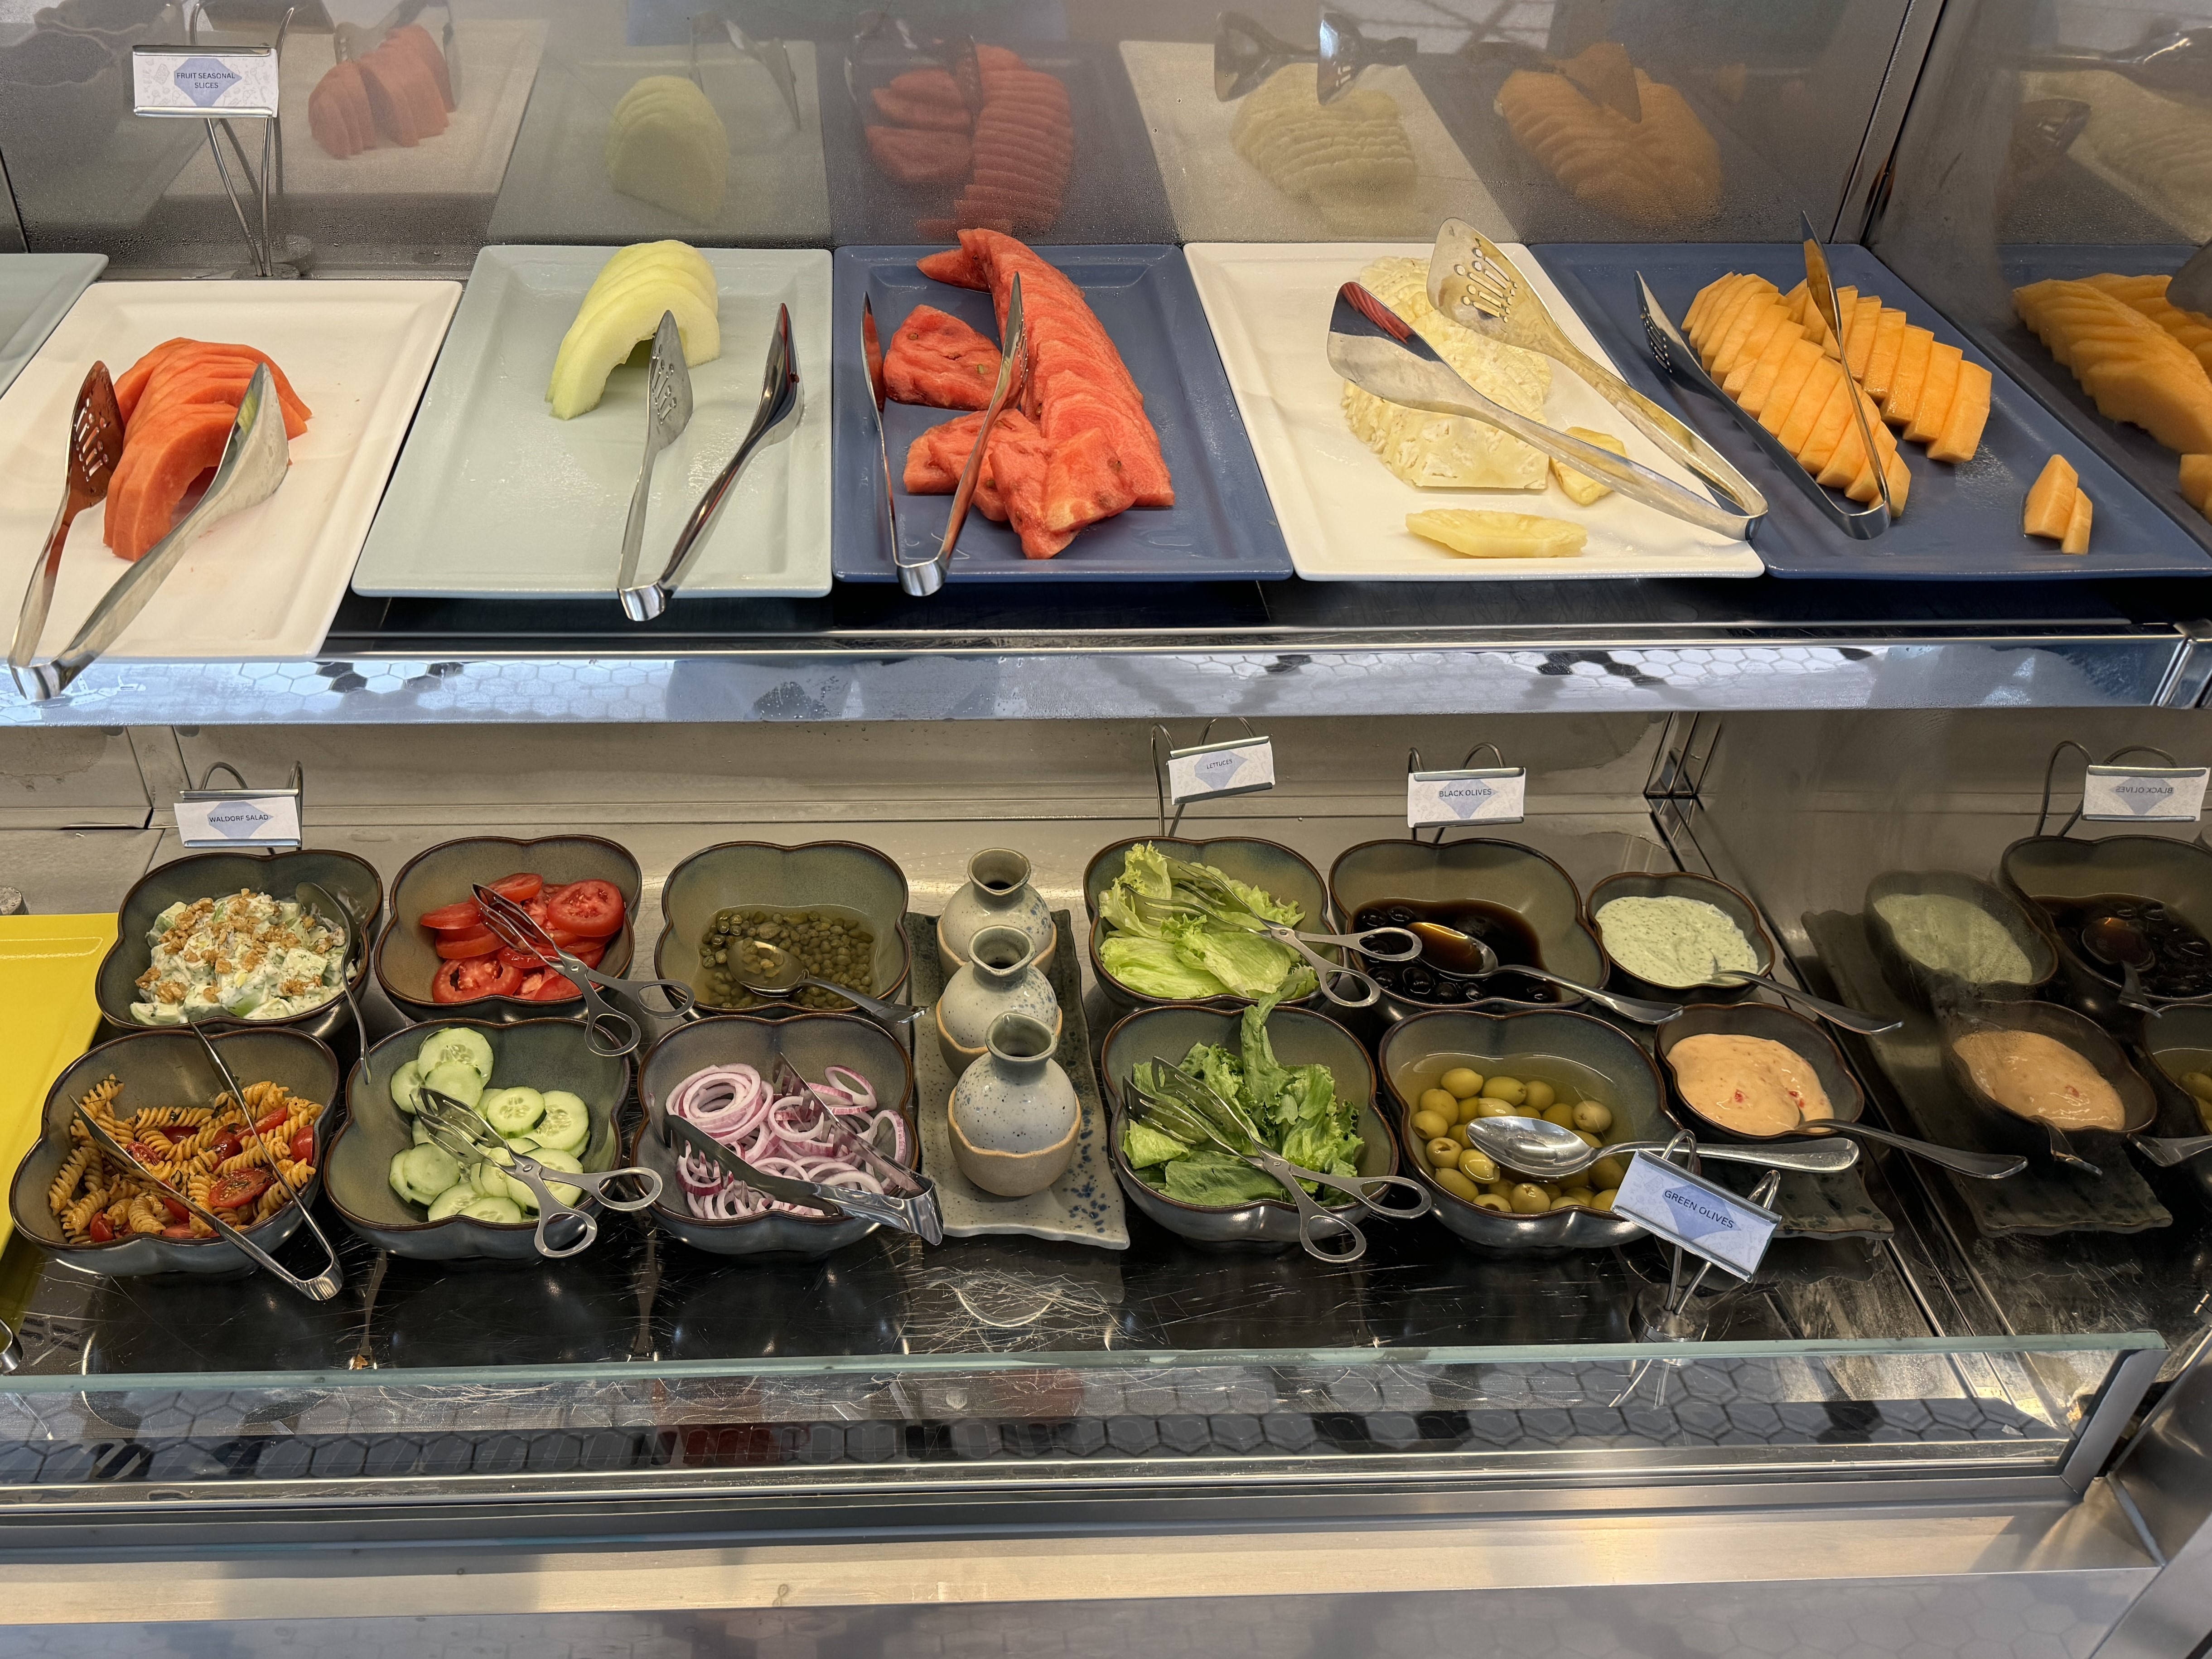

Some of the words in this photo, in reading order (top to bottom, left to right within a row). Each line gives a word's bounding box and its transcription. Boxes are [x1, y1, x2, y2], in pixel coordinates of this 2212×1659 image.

[1207, 759, 1232, 769] LETTUCES
[1664, 1190, 1697, 1211] GREEN
[1699, 1206, 1734, 1229] OLIVES
